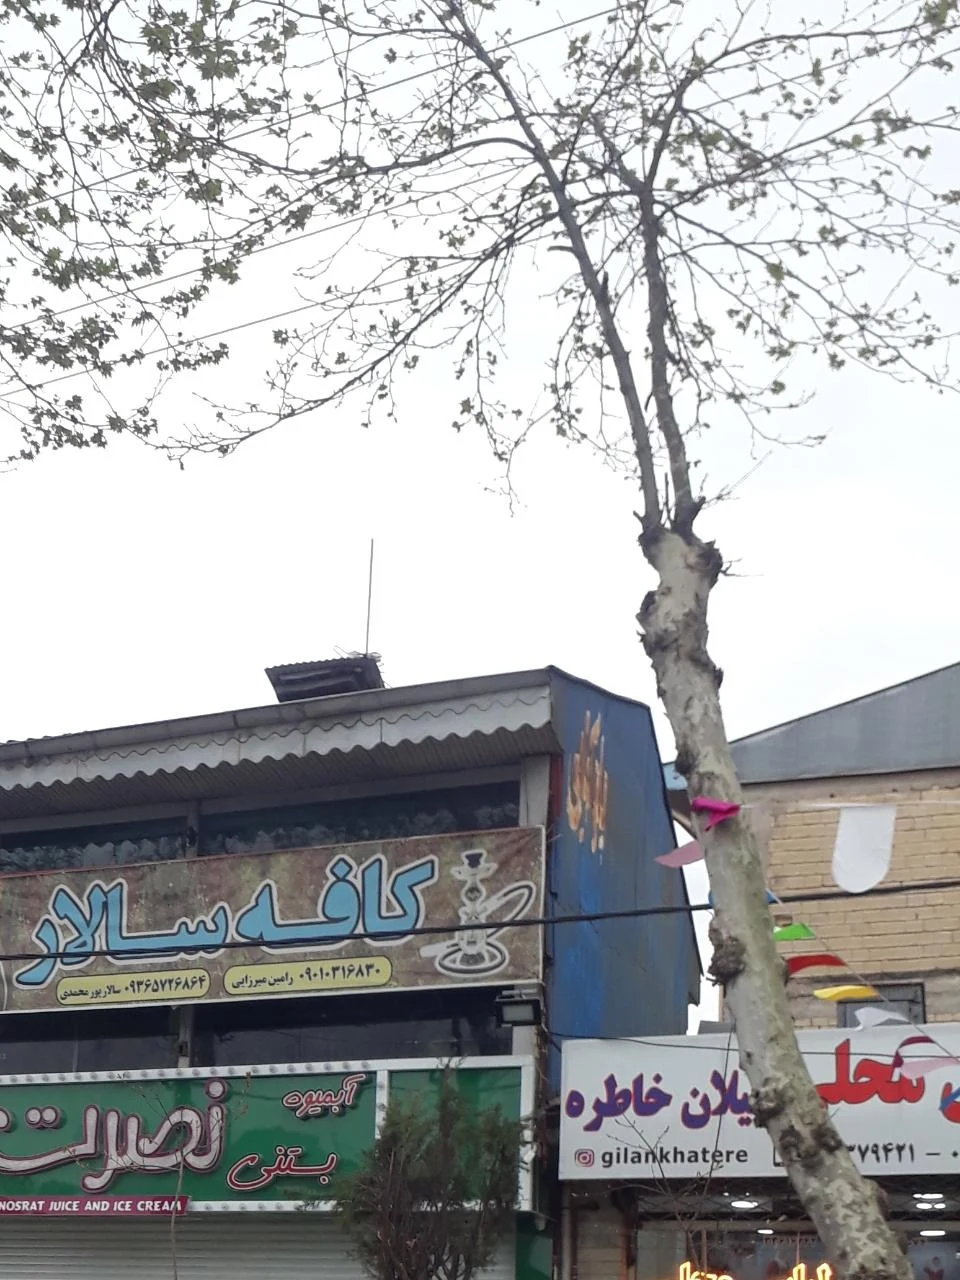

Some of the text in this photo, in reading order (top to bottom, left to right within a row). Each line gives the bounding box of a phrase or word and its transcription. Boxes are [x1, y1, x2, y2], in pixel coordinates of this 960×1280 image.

[14, 854, 439, 989] کافه سالار
[231, 963, 381, 989] ۰۹۰۱۰۳۱۶۸۳۰ رامین میرزایی
[283, 1073, 366, 1117] آبمیوه
[565, 1069, 754, 1132] یلان خاطره
[227, 1146, 337, 1190] بستنی
[601, 1147, 749, 1168] gilankhatere
[48, 1200, 80, 1212] JUICE
[84, 1200, 110, 1212] AND
[113, 1200, 132, 1212] ICE
[137, 1200, 182, 1212] CREAM
